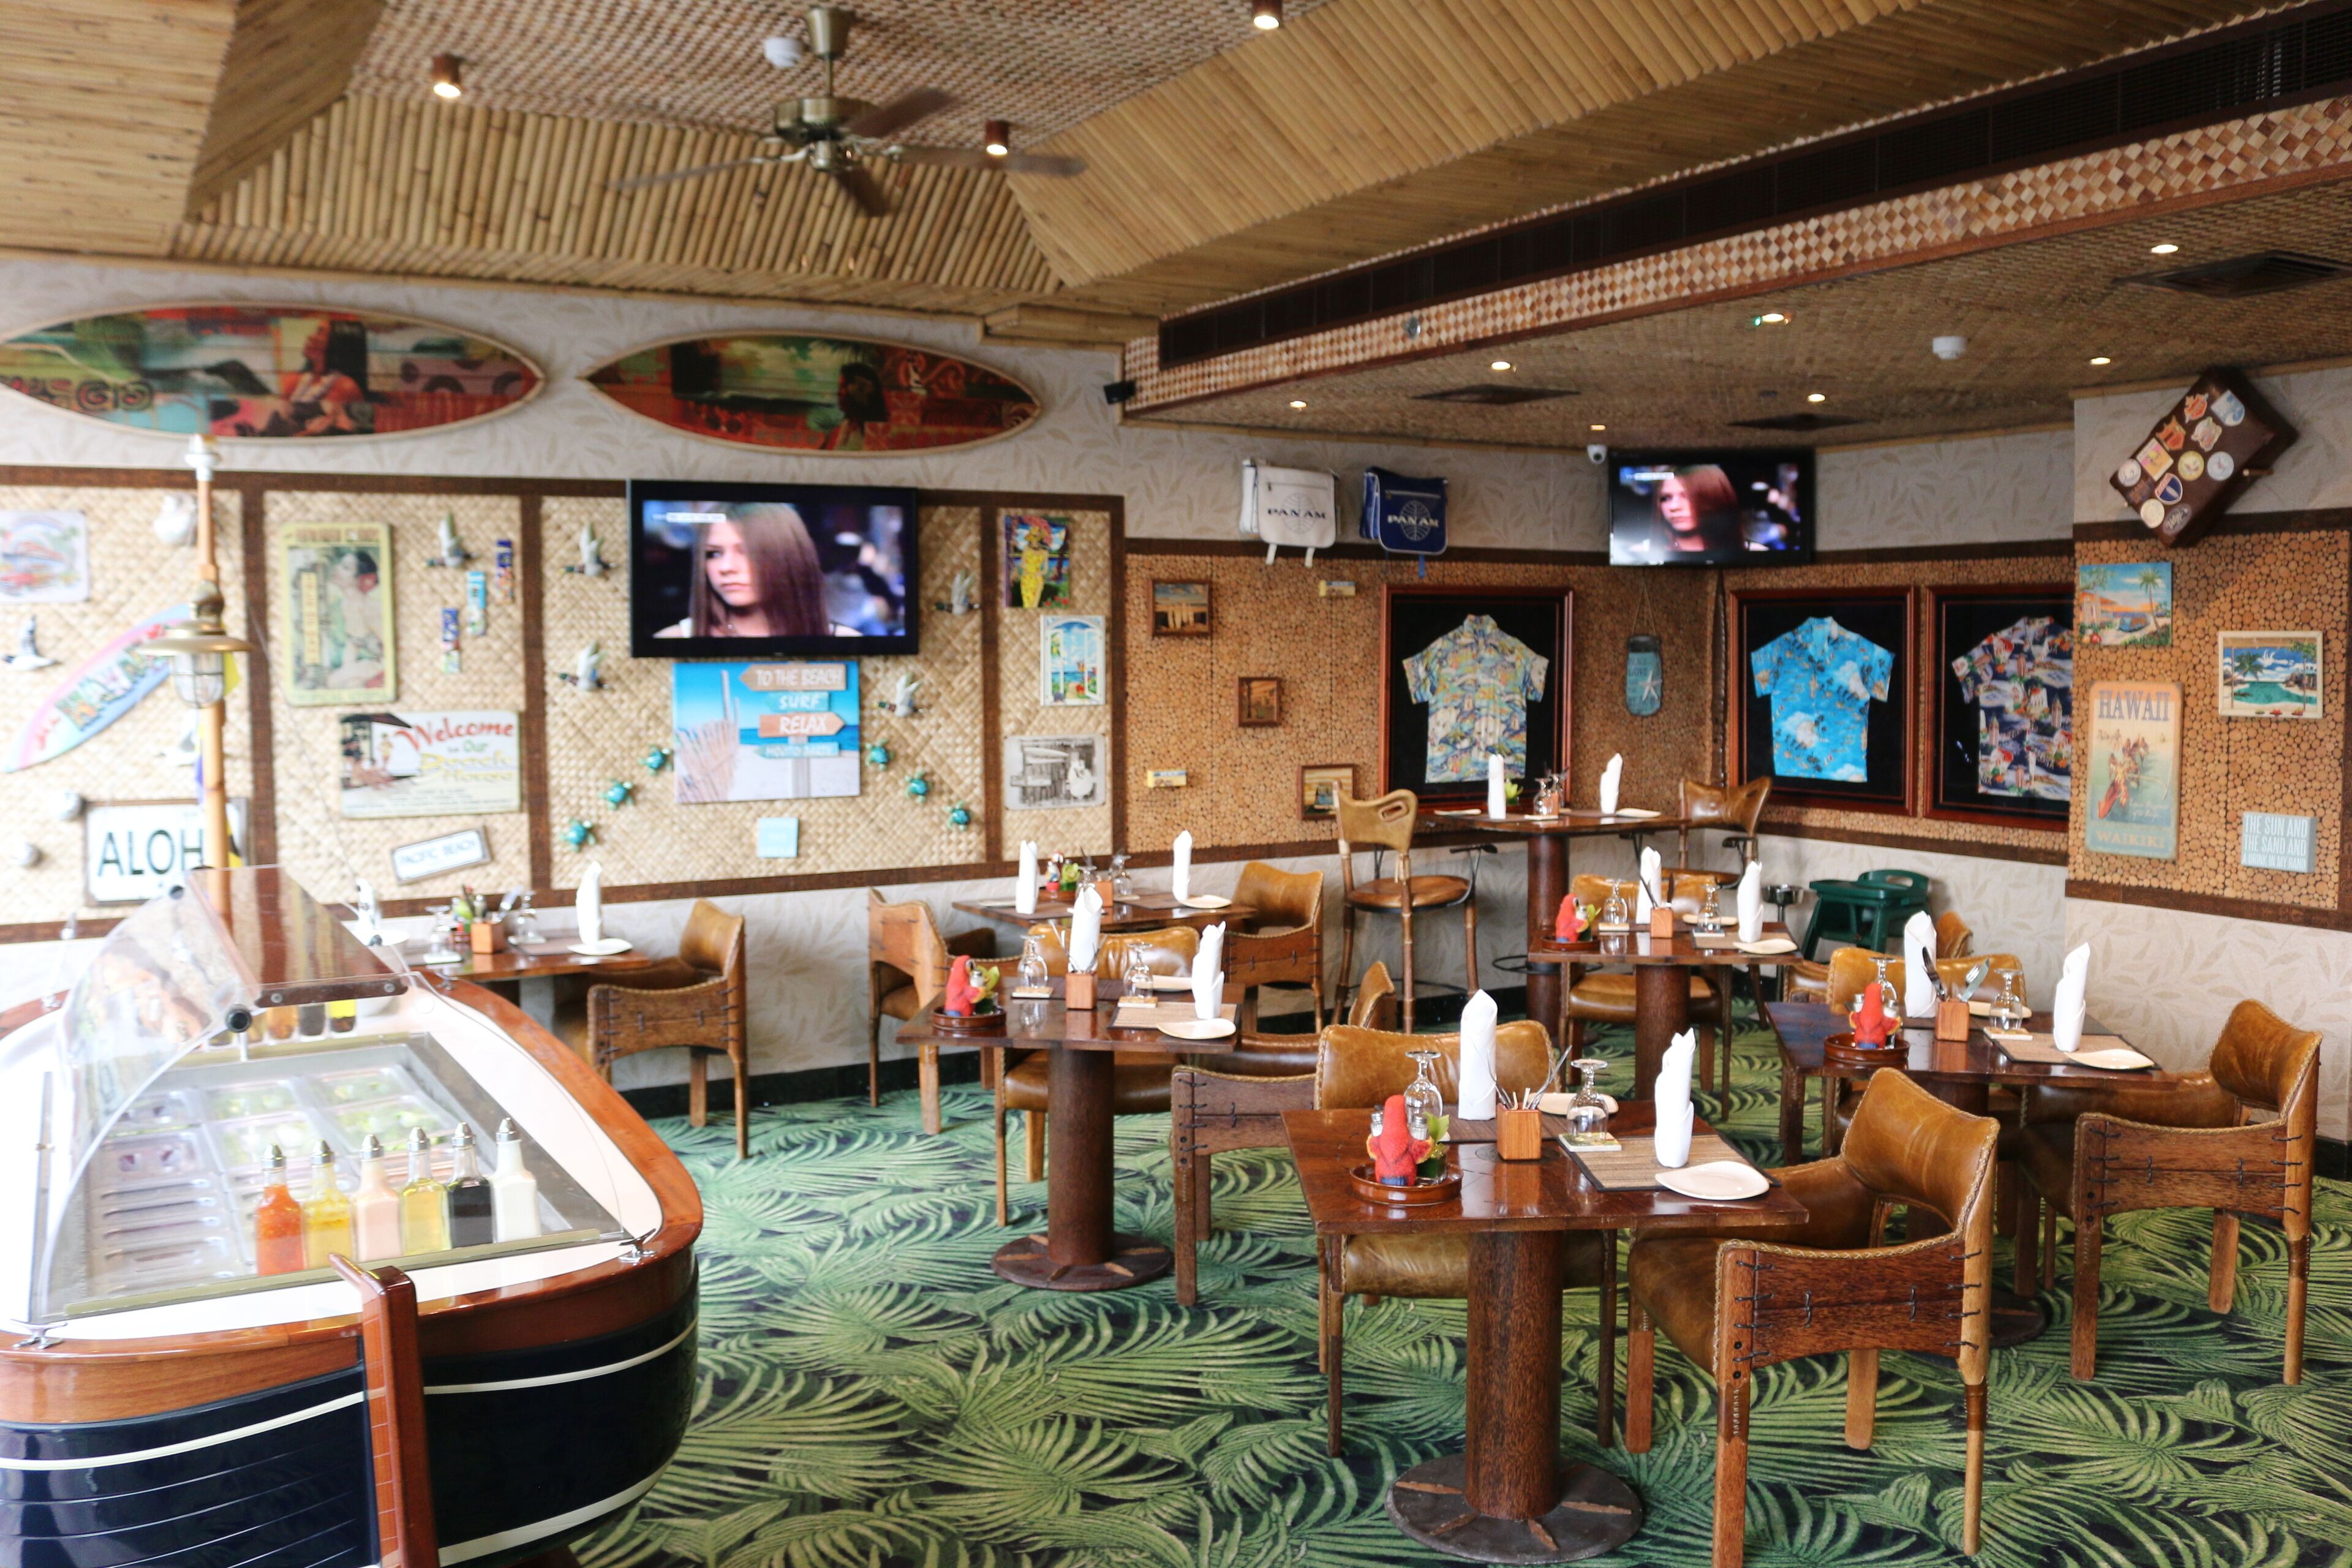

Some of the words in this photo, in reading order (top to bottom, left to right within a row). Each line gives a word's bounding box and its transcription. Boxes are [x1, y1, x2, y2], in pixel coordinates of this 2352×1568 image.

[1267, 508, 1300, 518] PAN
[1303, 510, 1327, 519] AM
[1387, 514, 1417, 525] PAN
[1420, 517, 1440, 527] AM
[755, 669, 774, 687] TO
[775, 668, 799, 686] THE
[801, 668, 843, 685] BEACH
[779, 695, 821, 710] SURF
[2098, 690, 2170, 722] HAWAII
[394, 717, 514, 751] Welcome
[779, 715, 827, 735] RELAX
[462, 739, 489, 753] Our
[2244, 815, 2262, 834] THE
[2264, 816, 2285, 837] SUN
[2286, 818, 2308, 838] AND
[2095, 830, 2166, 848] WAIKIKI
[2244, 834, 2259, 852] THE
[2261, 835, 2286, 854] SAND
[2287, 838, 2307, 857] AND
[97, 828, 203, 878] ALOH
[2242, 852, 2247, 865] A
[2248, 853, 2267, 866] DRINK
[2269, 854, 2276, 867] IN
[2277, 855, 2288, 869] MY
[2288, 856, 2307, 870] HAND
